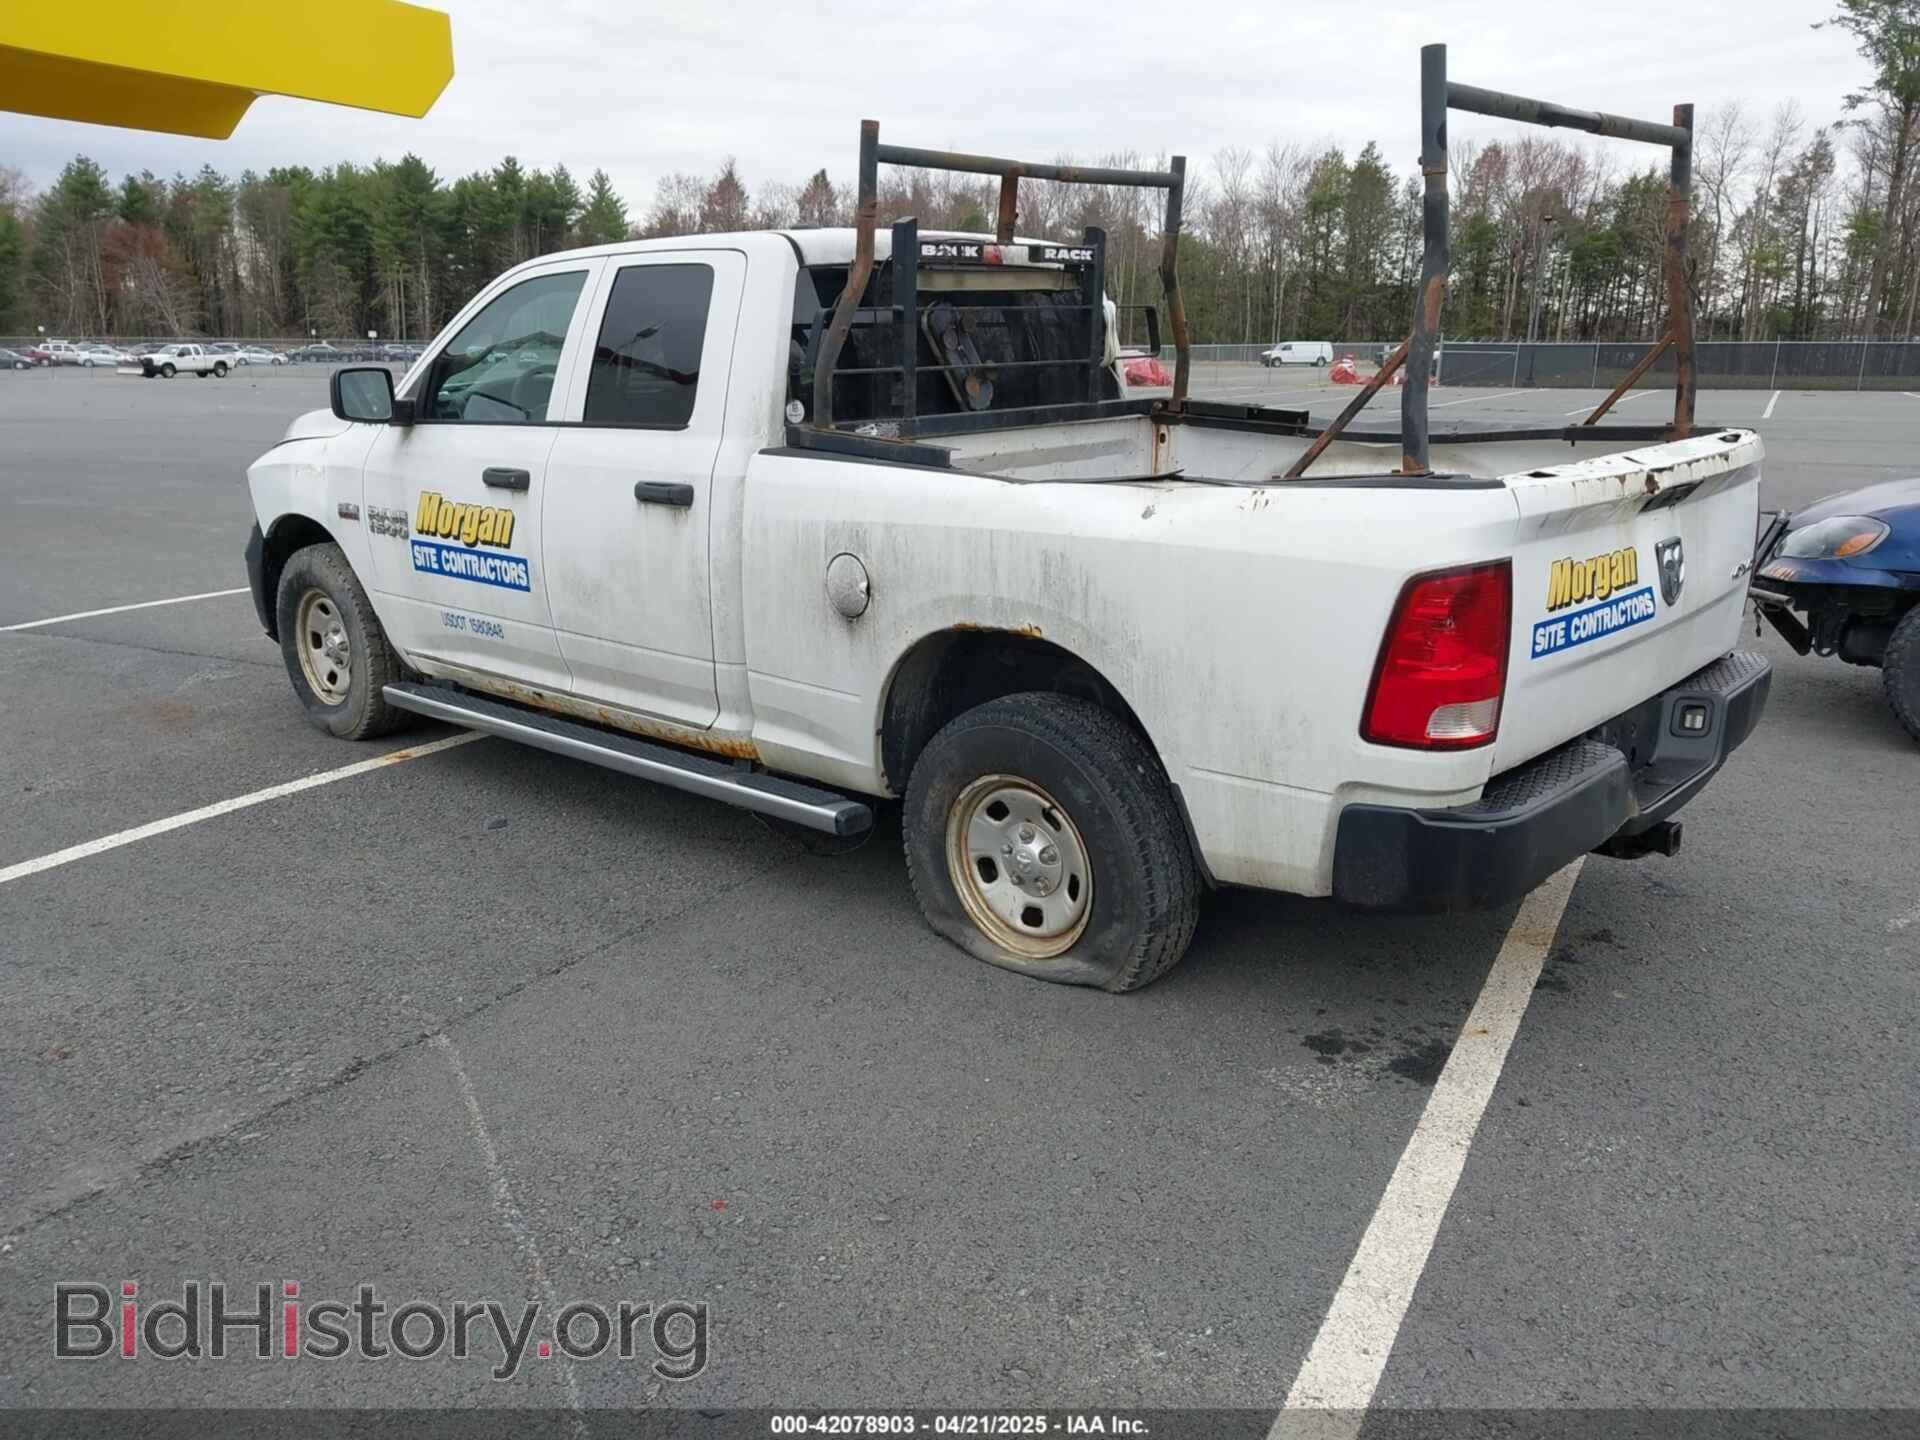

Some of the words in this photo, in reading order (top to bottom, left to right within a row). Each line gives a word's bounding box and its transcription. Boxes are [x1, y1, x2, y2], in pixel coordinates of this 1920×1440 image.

[1044, 248, 1093, 261] RACK
[416, 490, 516, 549] Morgan
[413, 544, 440, 570] SITE
[441, 549, 529, 587] CONTRACTORS
[1546, 546, 1639, 613] Morgan
[1534, 620, 1566, 653] SITE
[1570, 592, 1655, 642] CONTRACTORS
